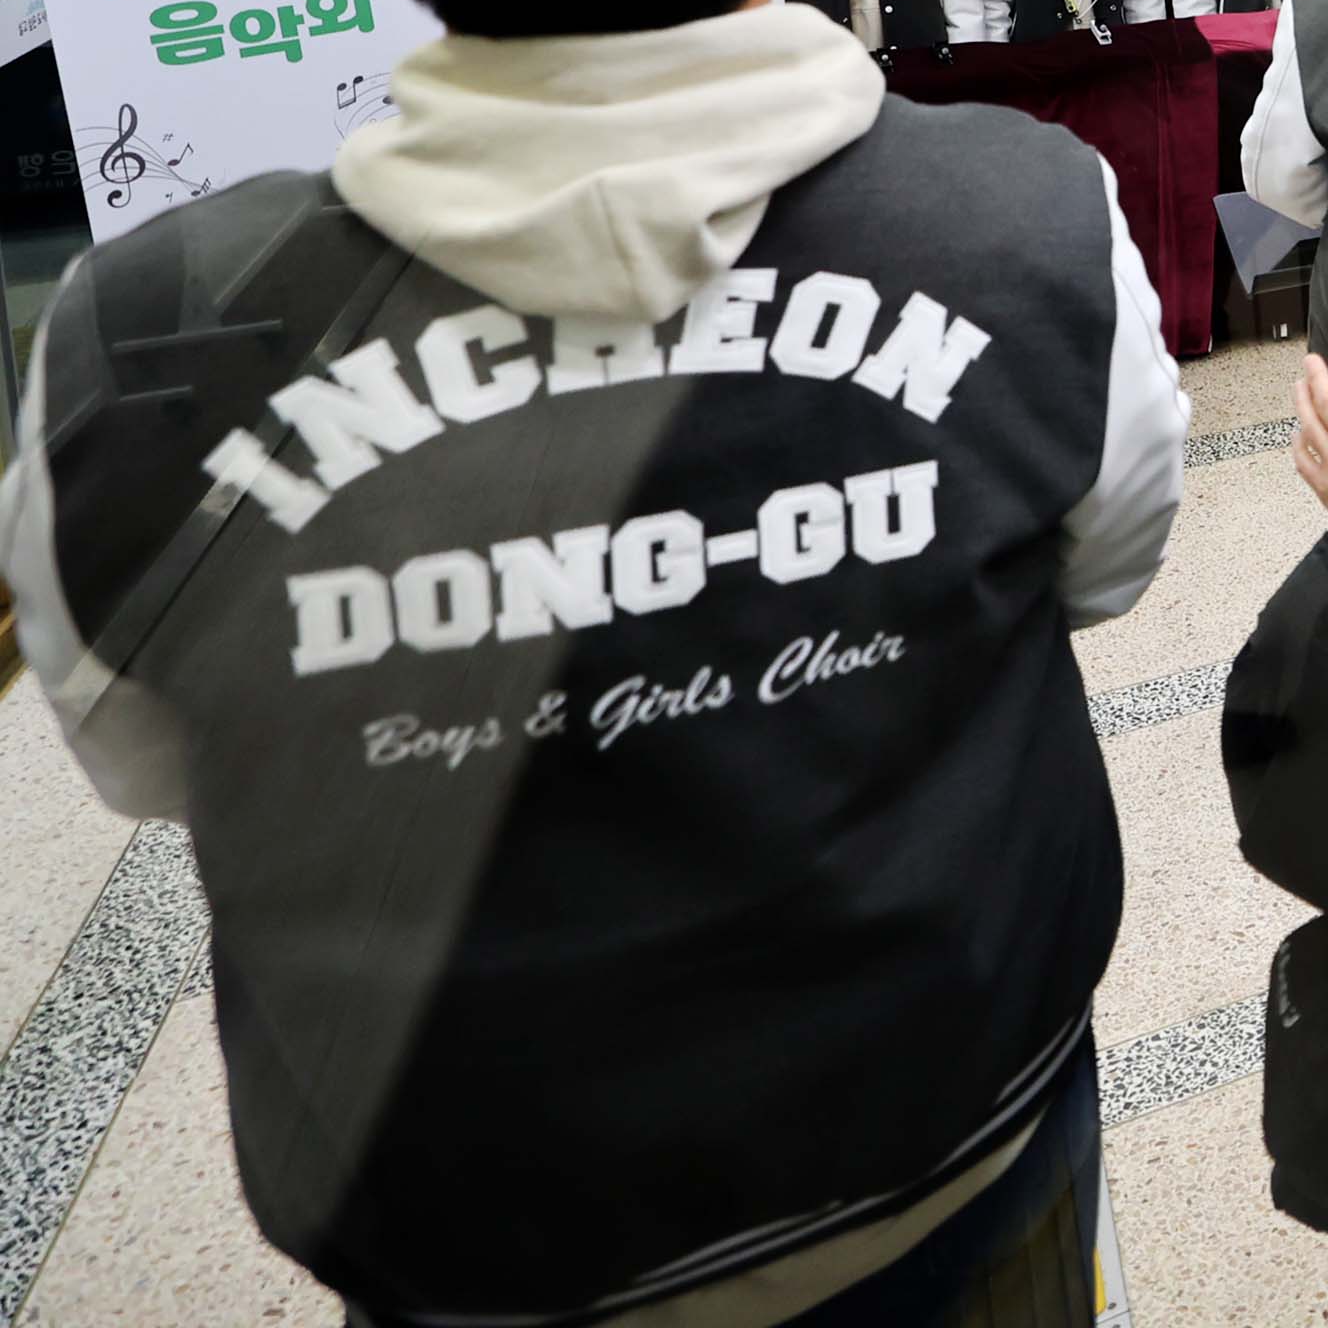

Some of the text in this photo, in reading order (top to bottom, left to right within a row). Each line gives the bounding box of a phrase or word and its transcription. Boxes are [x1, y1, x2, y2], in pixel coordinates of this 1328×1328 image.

[202, 266, 992, 534] INCHEON
[287, 459, 939, 677] DONG-GU
[362, 630, 907, 771] Boys & Girls Choir
